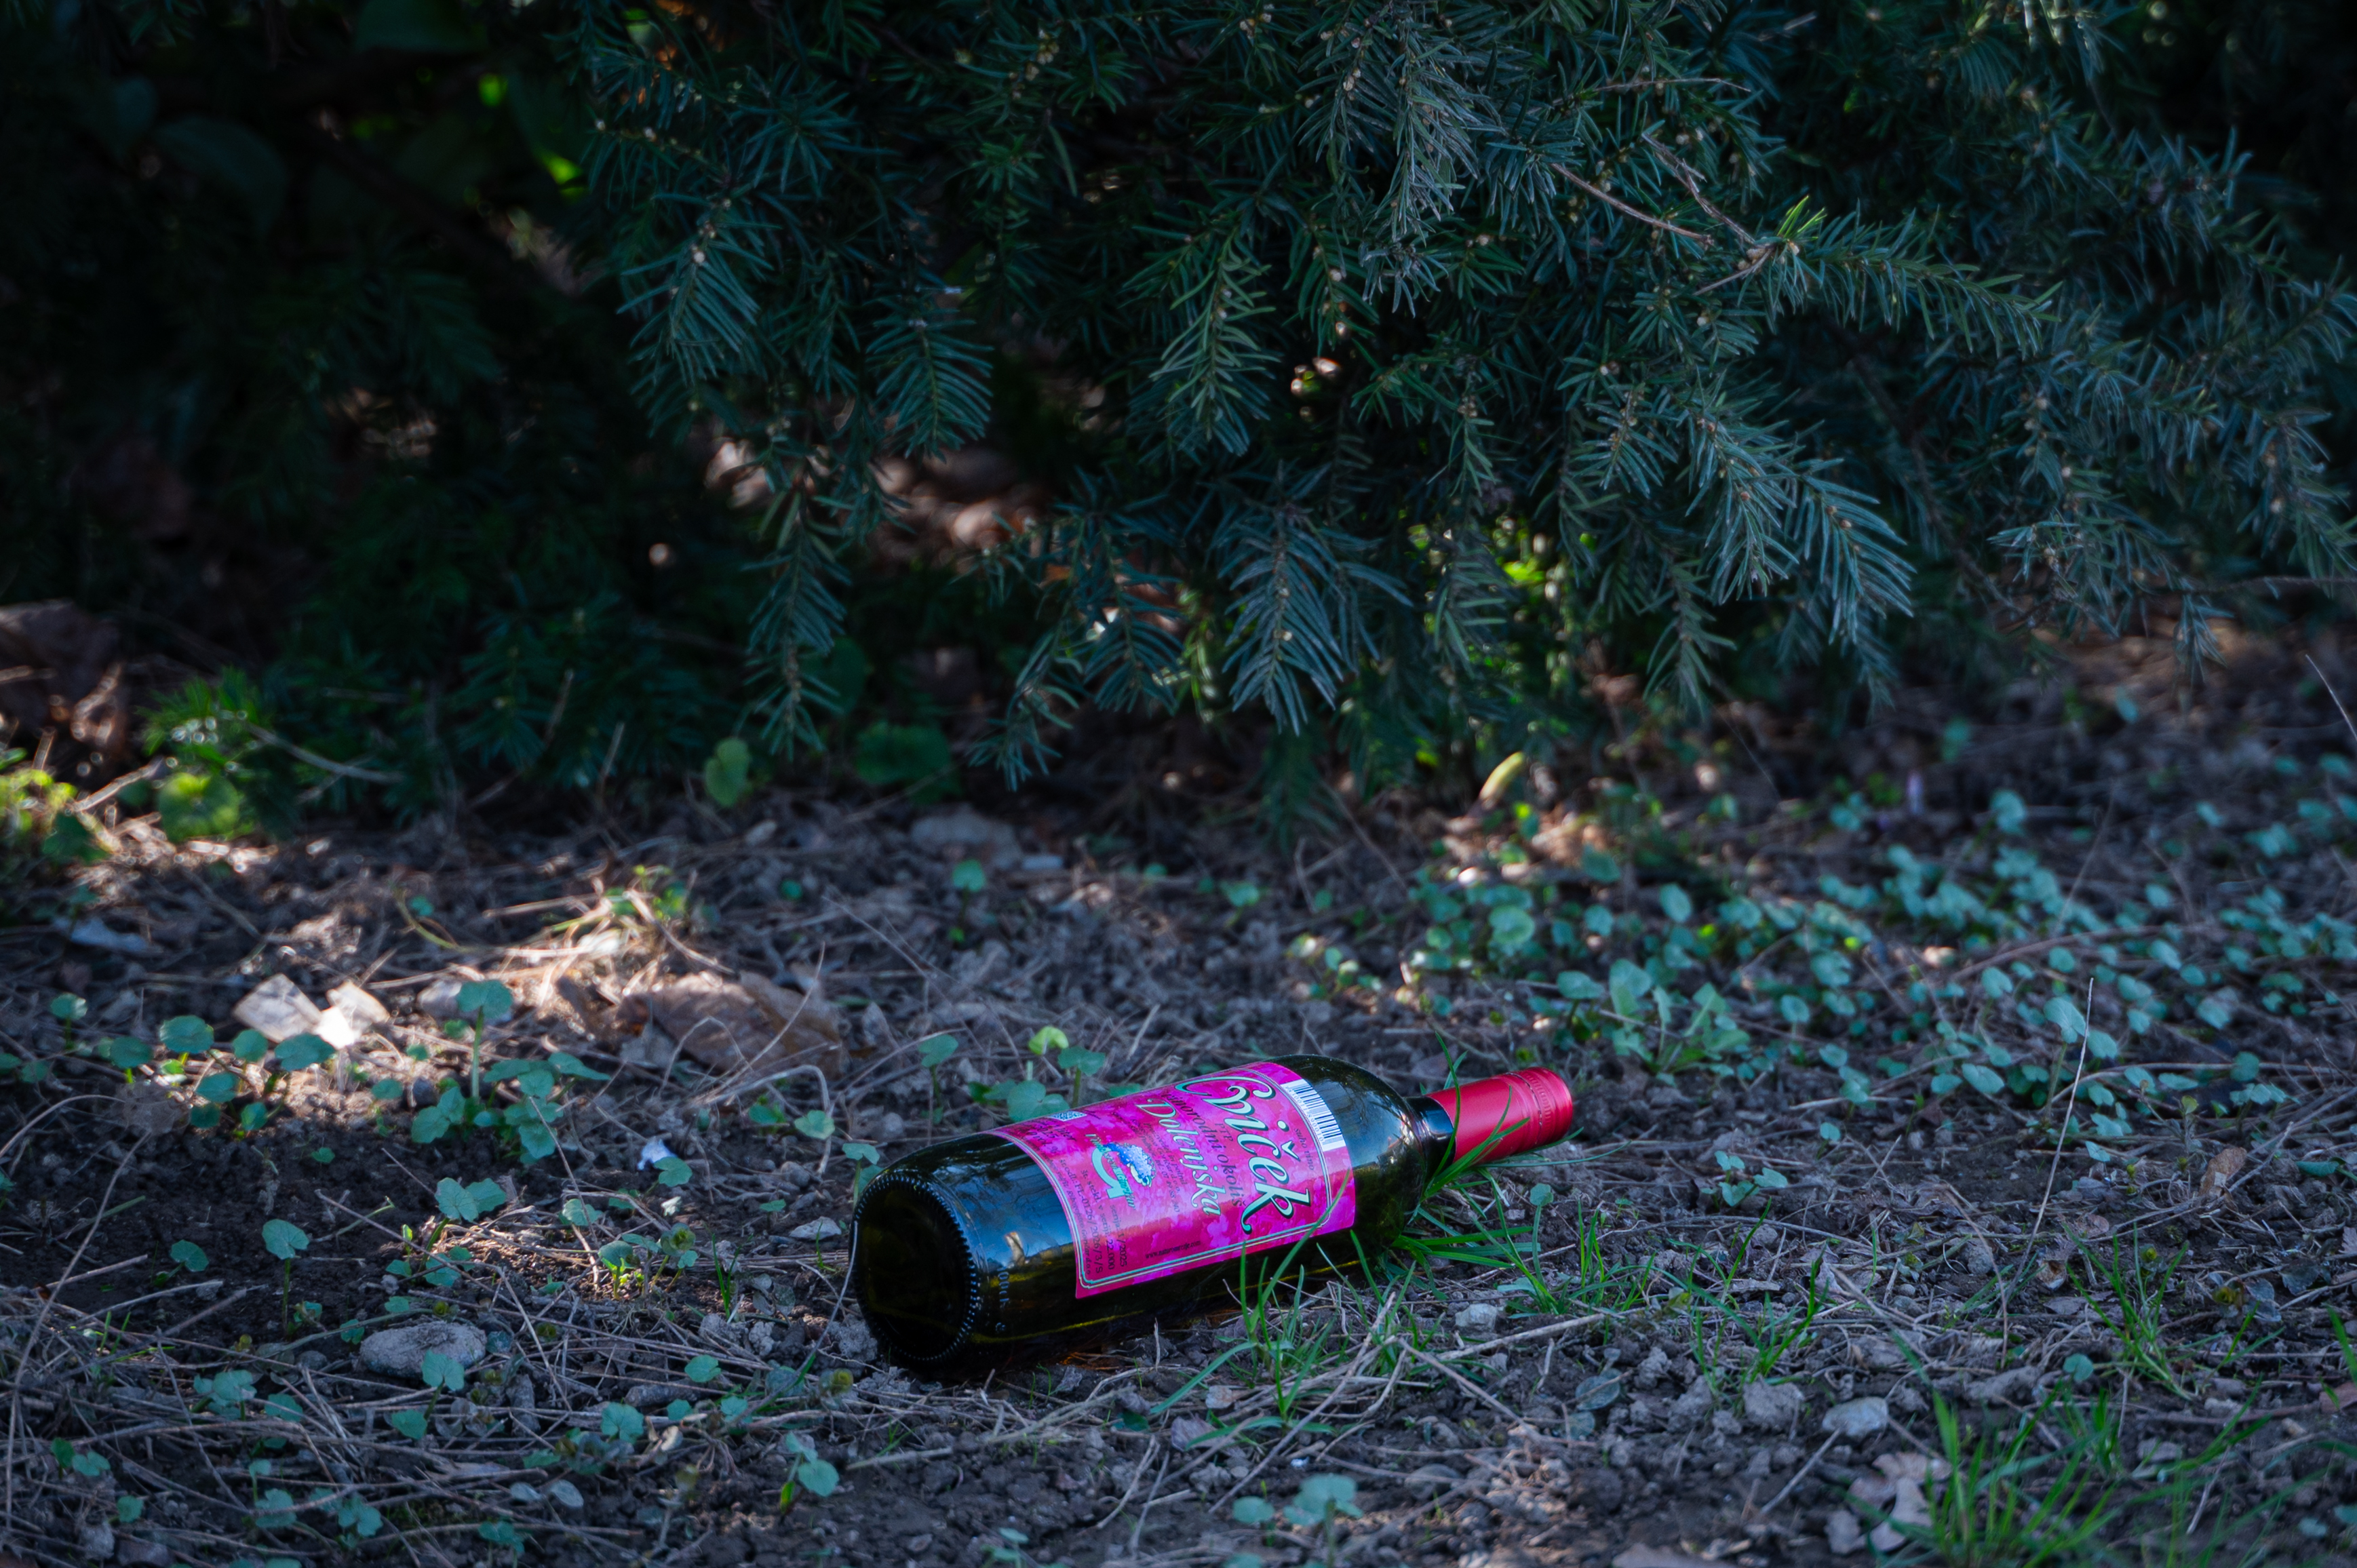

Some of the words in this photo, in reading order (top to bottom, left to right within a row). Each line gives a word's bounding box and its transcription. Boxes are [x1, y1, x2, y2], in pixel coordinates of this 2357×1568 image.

[1135, 1097, 1225, 1216] Dolenjska
[1175, 1076, 1311, 1234] Cviček
[1294, 1127, 1308, 1148] suho
[1304, 1150, 1315, 1171] vino
[1216, 1152, 1247, 1209] okoliš
[1106, 1239, 1115, 1270] 22.000
[1109, 1204, 1122, 1231] serija:
[1116, 1233, 1127, 1268] 1/2025
